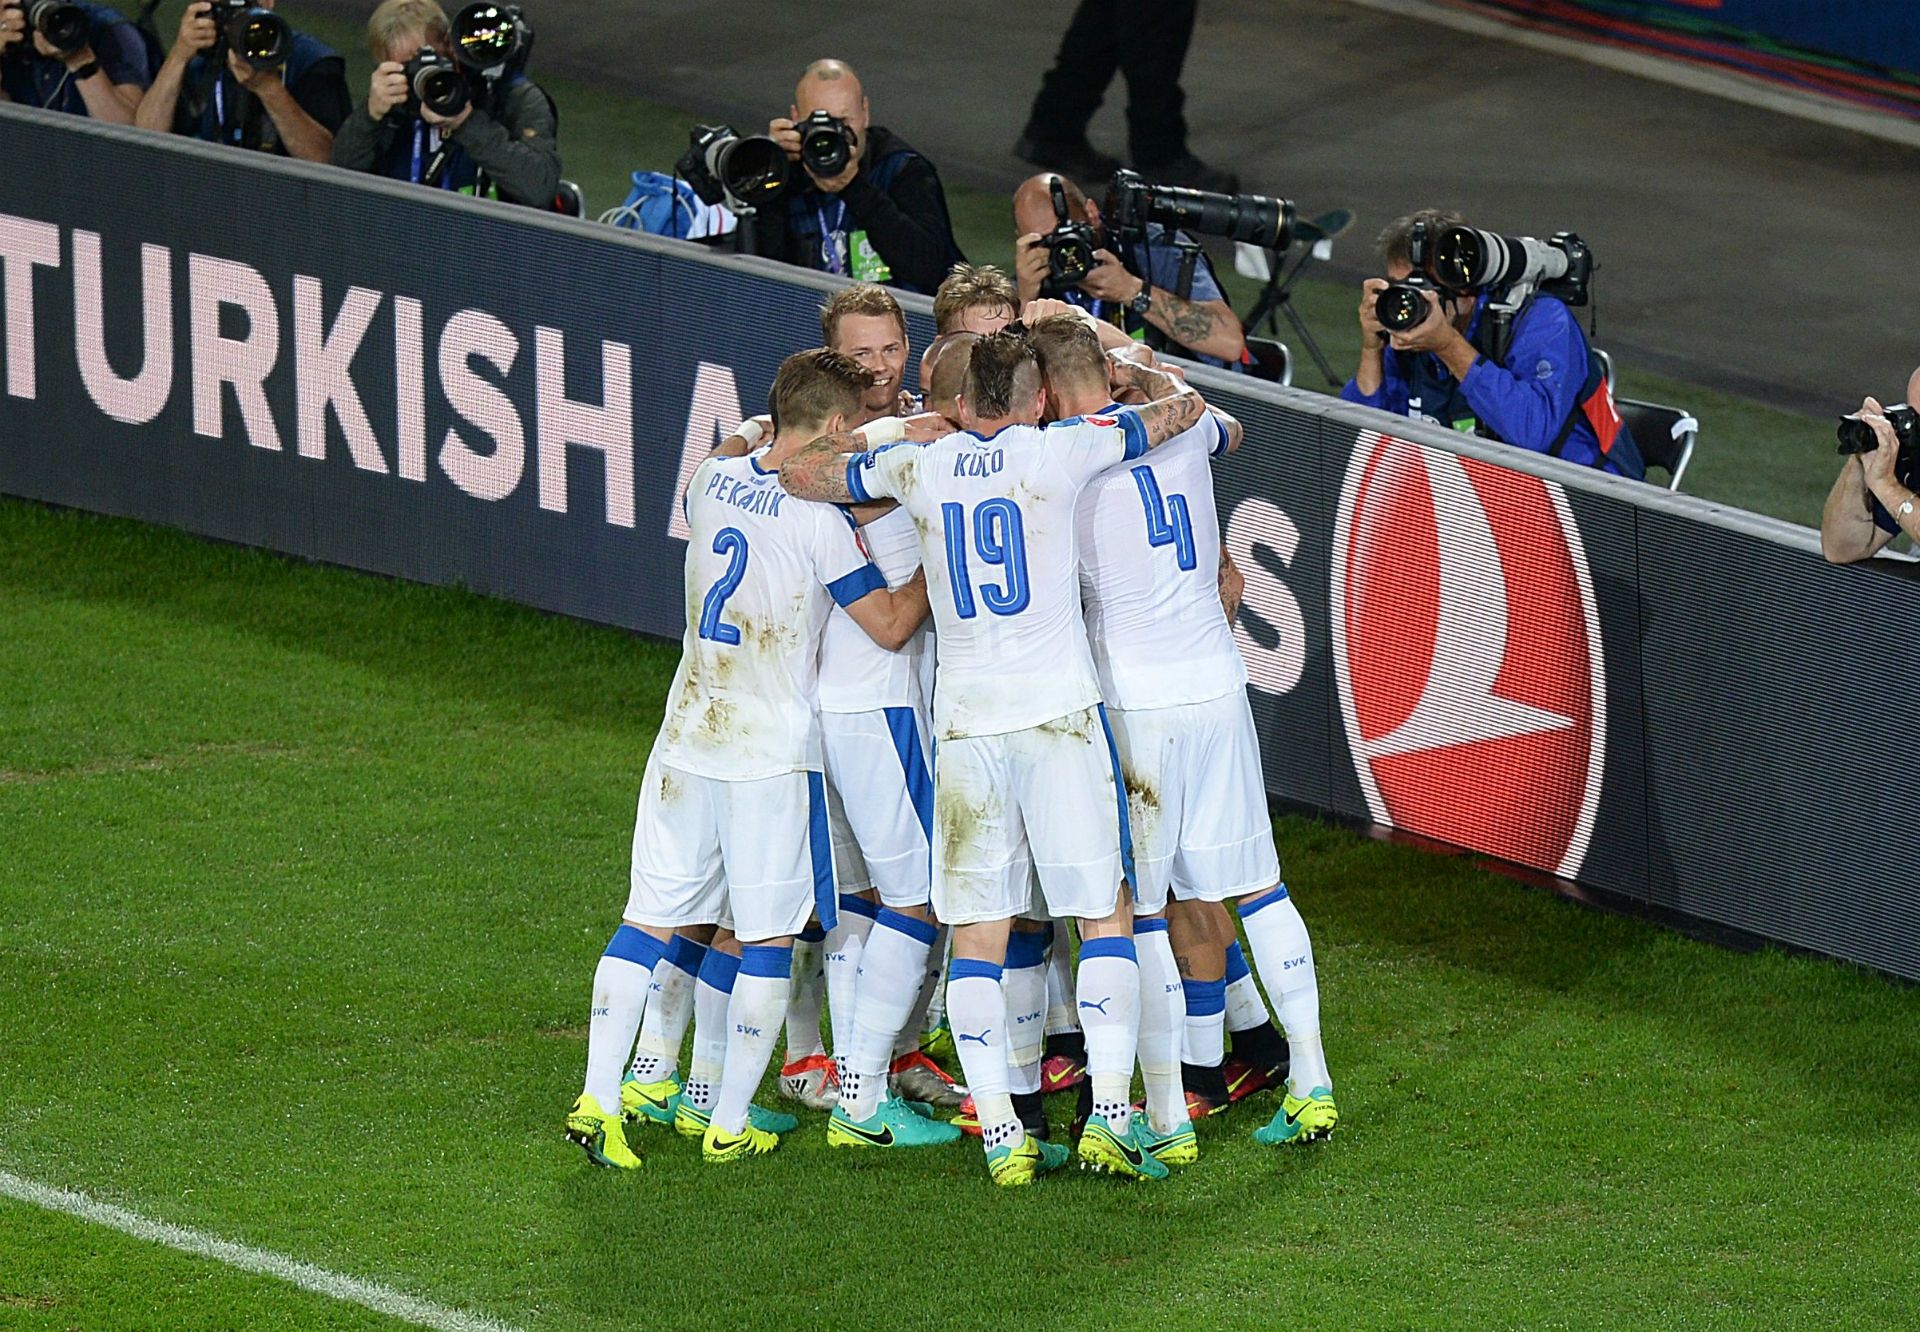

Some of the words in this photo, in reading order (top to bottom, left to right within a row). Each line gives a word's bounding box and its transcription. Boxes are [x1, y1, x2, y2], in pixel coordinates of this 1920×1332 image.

[0, 213, 635, 528] TURKISH
[1130, 465, 1197, 572] 4
[941, 497, 1030, 619] 19
[699, 527, 748, 646] 2
[825, 953, 846, 961] SVK
[1284, 955, 1306, 970] SVK
[593, 1008, 609, 1016] SVK
[1017, 1010, 1041, 1024] SVK
[737, 1025, 761, 1037] SVK
